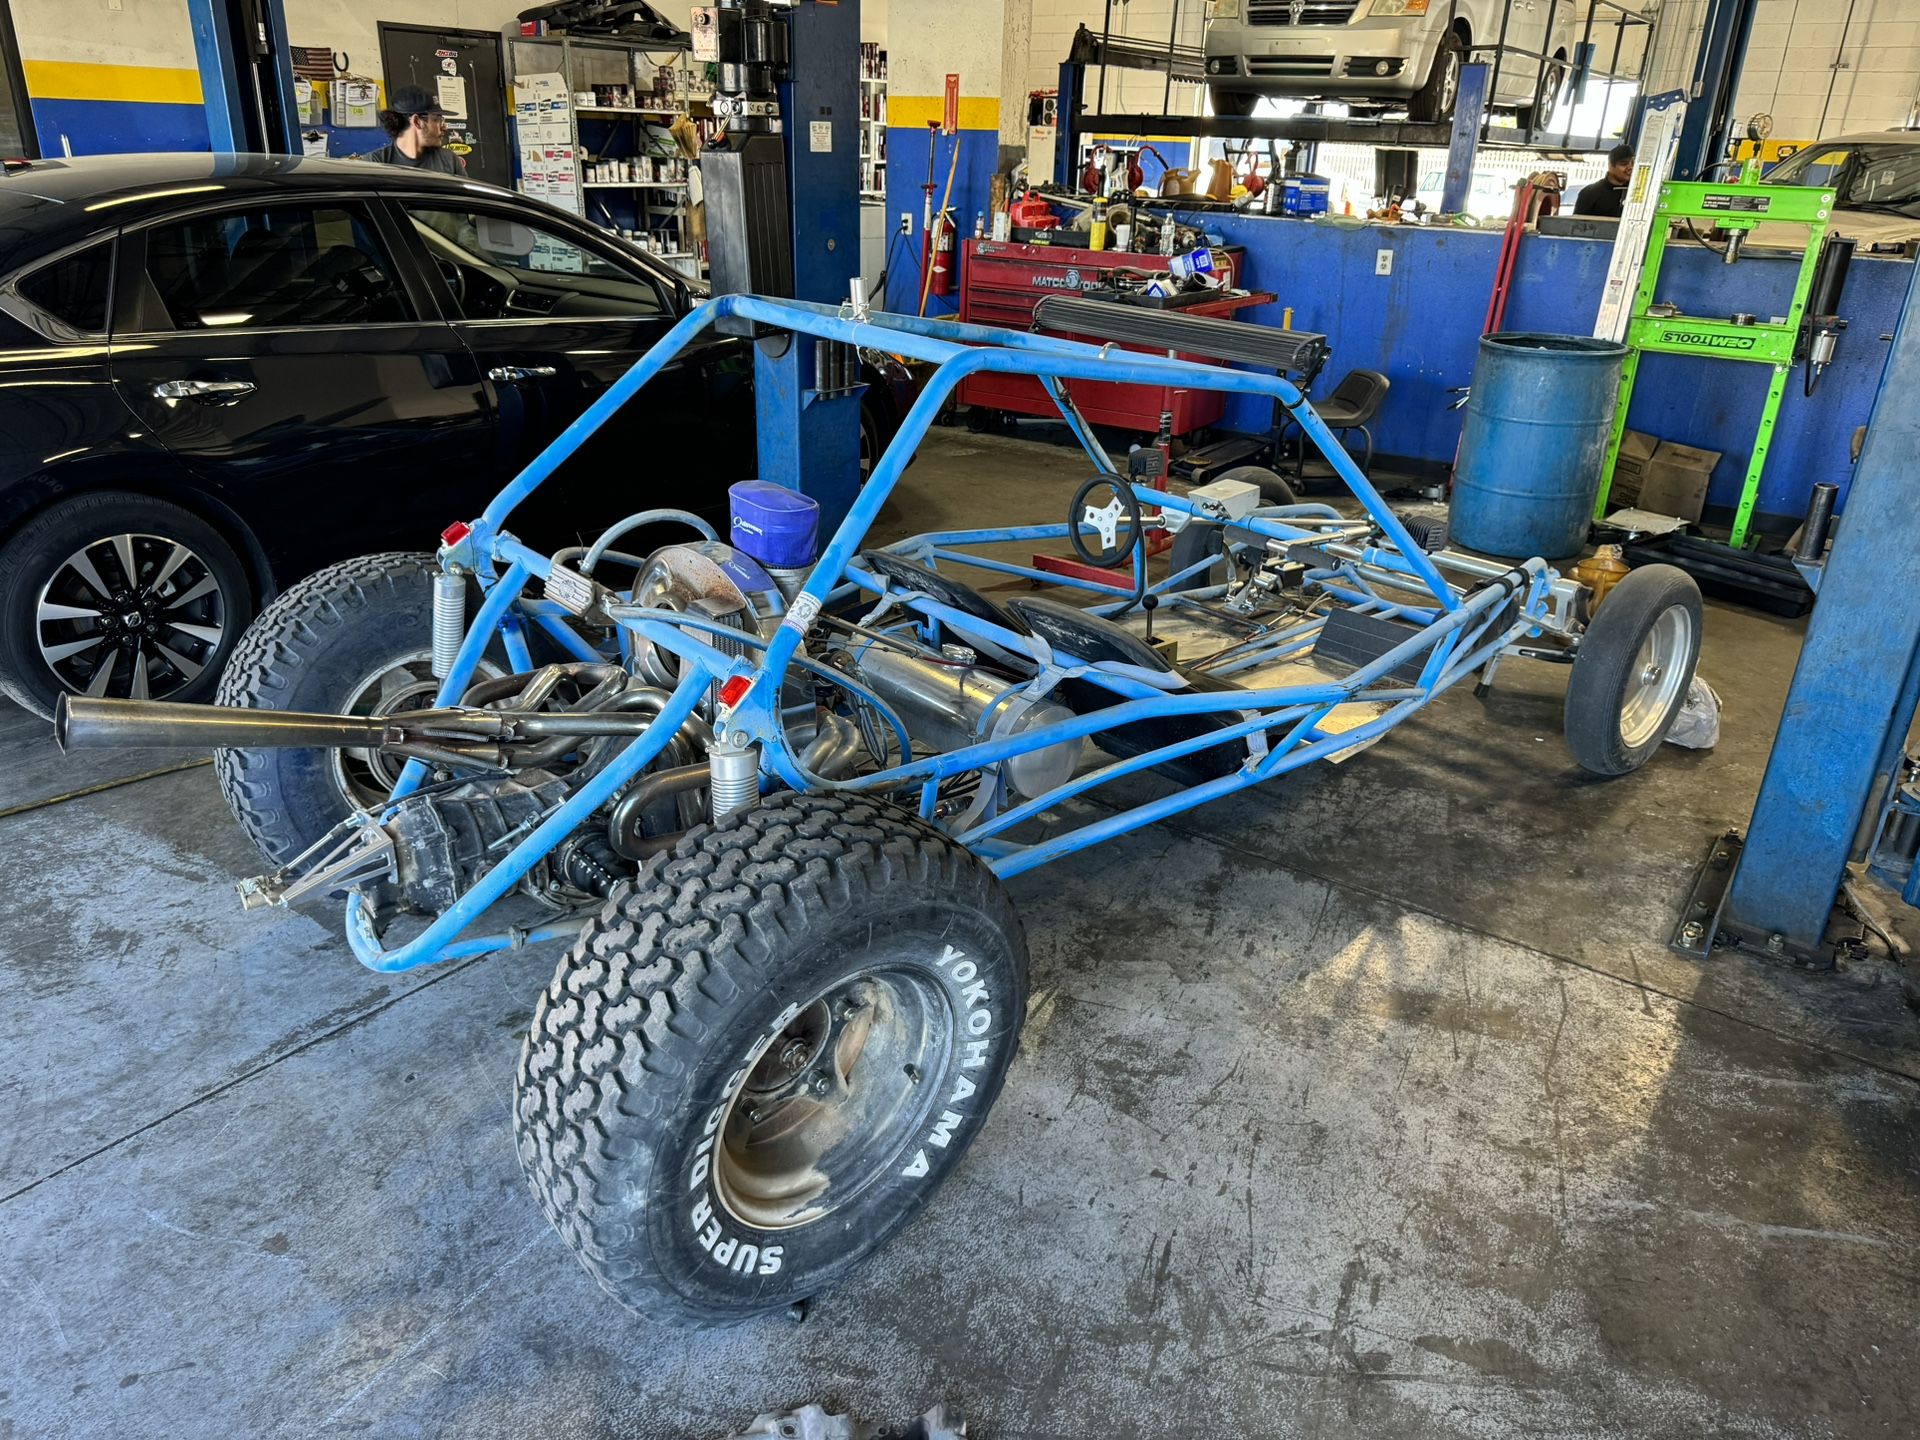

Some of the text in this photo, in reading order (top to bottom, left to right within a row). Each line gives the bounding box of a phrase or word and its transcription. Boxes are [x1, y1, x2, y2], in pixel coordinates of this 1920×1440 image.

[1031, 275, 1066, 288] MATCO
[902, 944, 992, 1178] YOKOHAMA
[691, 1192, 784, 1275] SUPER
